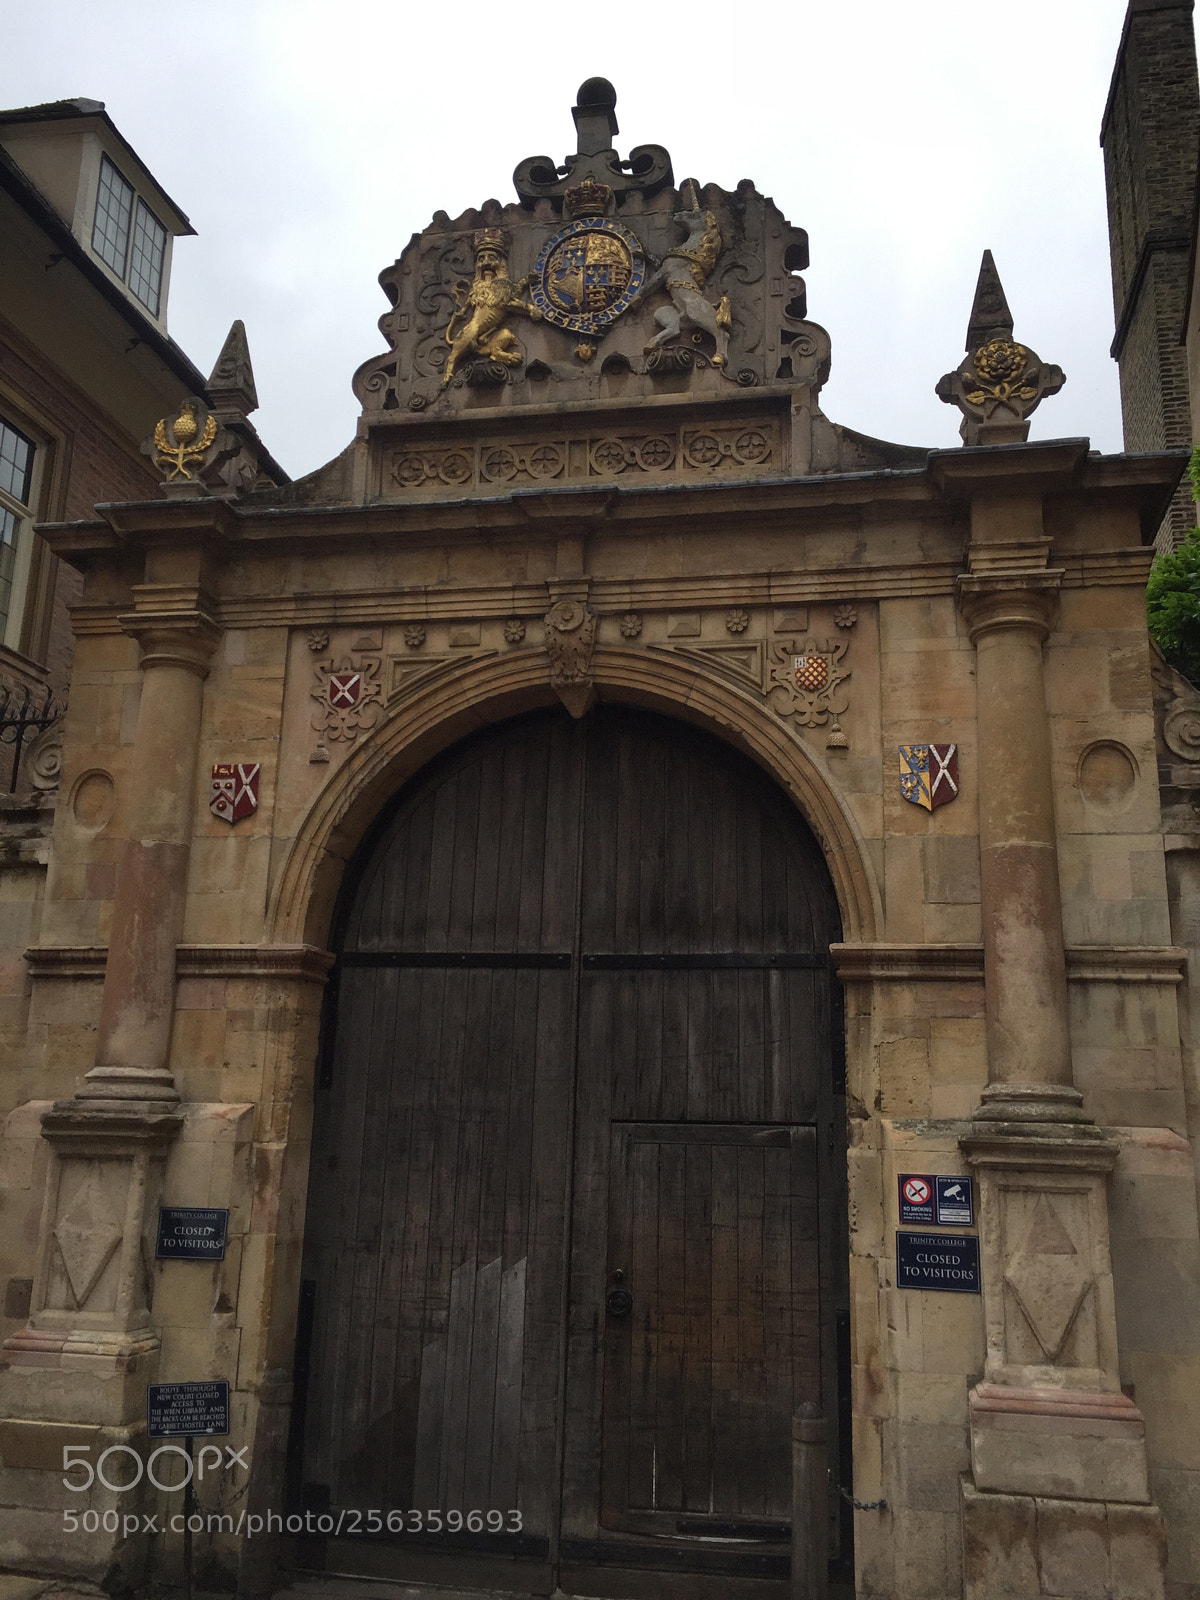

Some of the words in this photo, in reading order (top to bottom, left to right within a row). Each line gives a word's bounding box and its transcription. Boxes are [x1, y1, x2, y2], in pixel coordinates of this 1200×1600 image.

[174, 1226, 211, 1236] CLOSED
[163, 1239, 176, 1247] TO
[178, 1240, 221, 1248] VISITORS
[916, 1254, 960, 1265] CLOSED
[904, 1266, 920, 1276] TO
[922, 1268, 974, 1280] VISITORS
